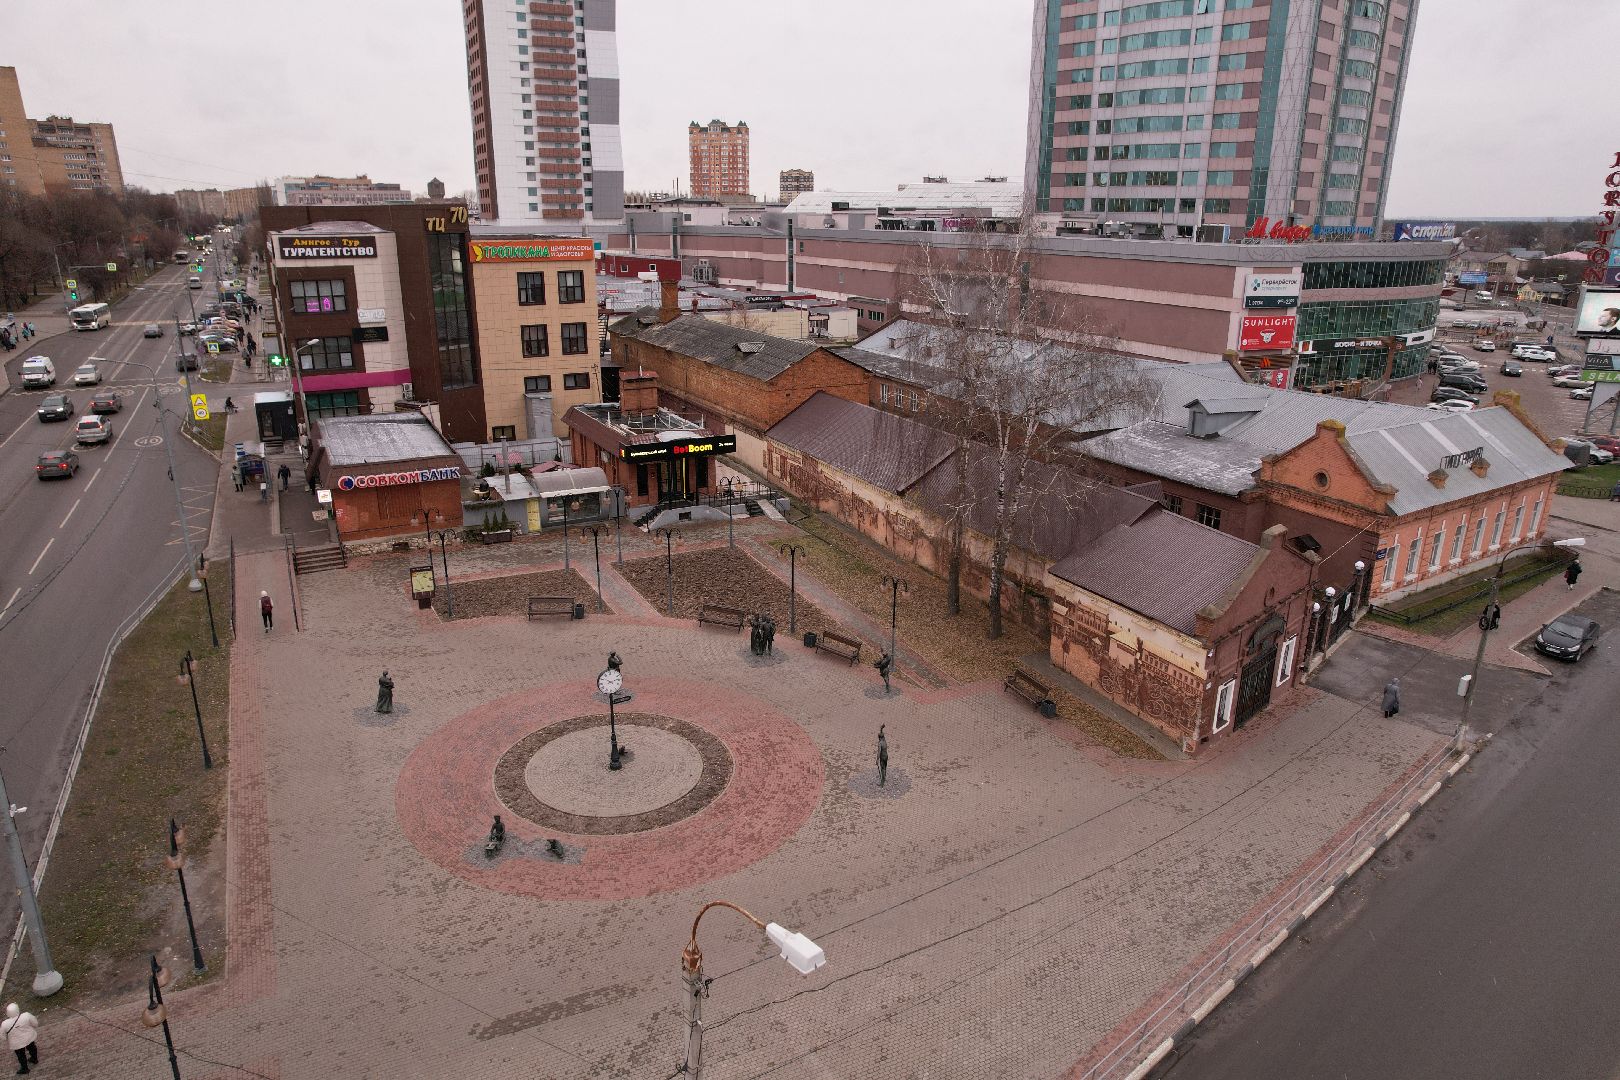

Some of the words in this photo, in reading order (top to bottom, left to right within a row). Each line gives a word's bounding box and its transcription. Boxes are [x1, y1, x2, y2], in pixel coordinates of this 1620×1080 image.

[450, 206, 468, 224] 70
[425, 216, 446, 233] ТЦ
[341, 238, 360, 247] Тур
[282, 246, 374, 257] ТУРАГЕНТСТВО
[483, 245, 550, 258] ТРОПИКАНА
[1244, 318, 1294, 327] SUNLIGHT
[355, 466, 461, 489] СОВКОМБАНК
